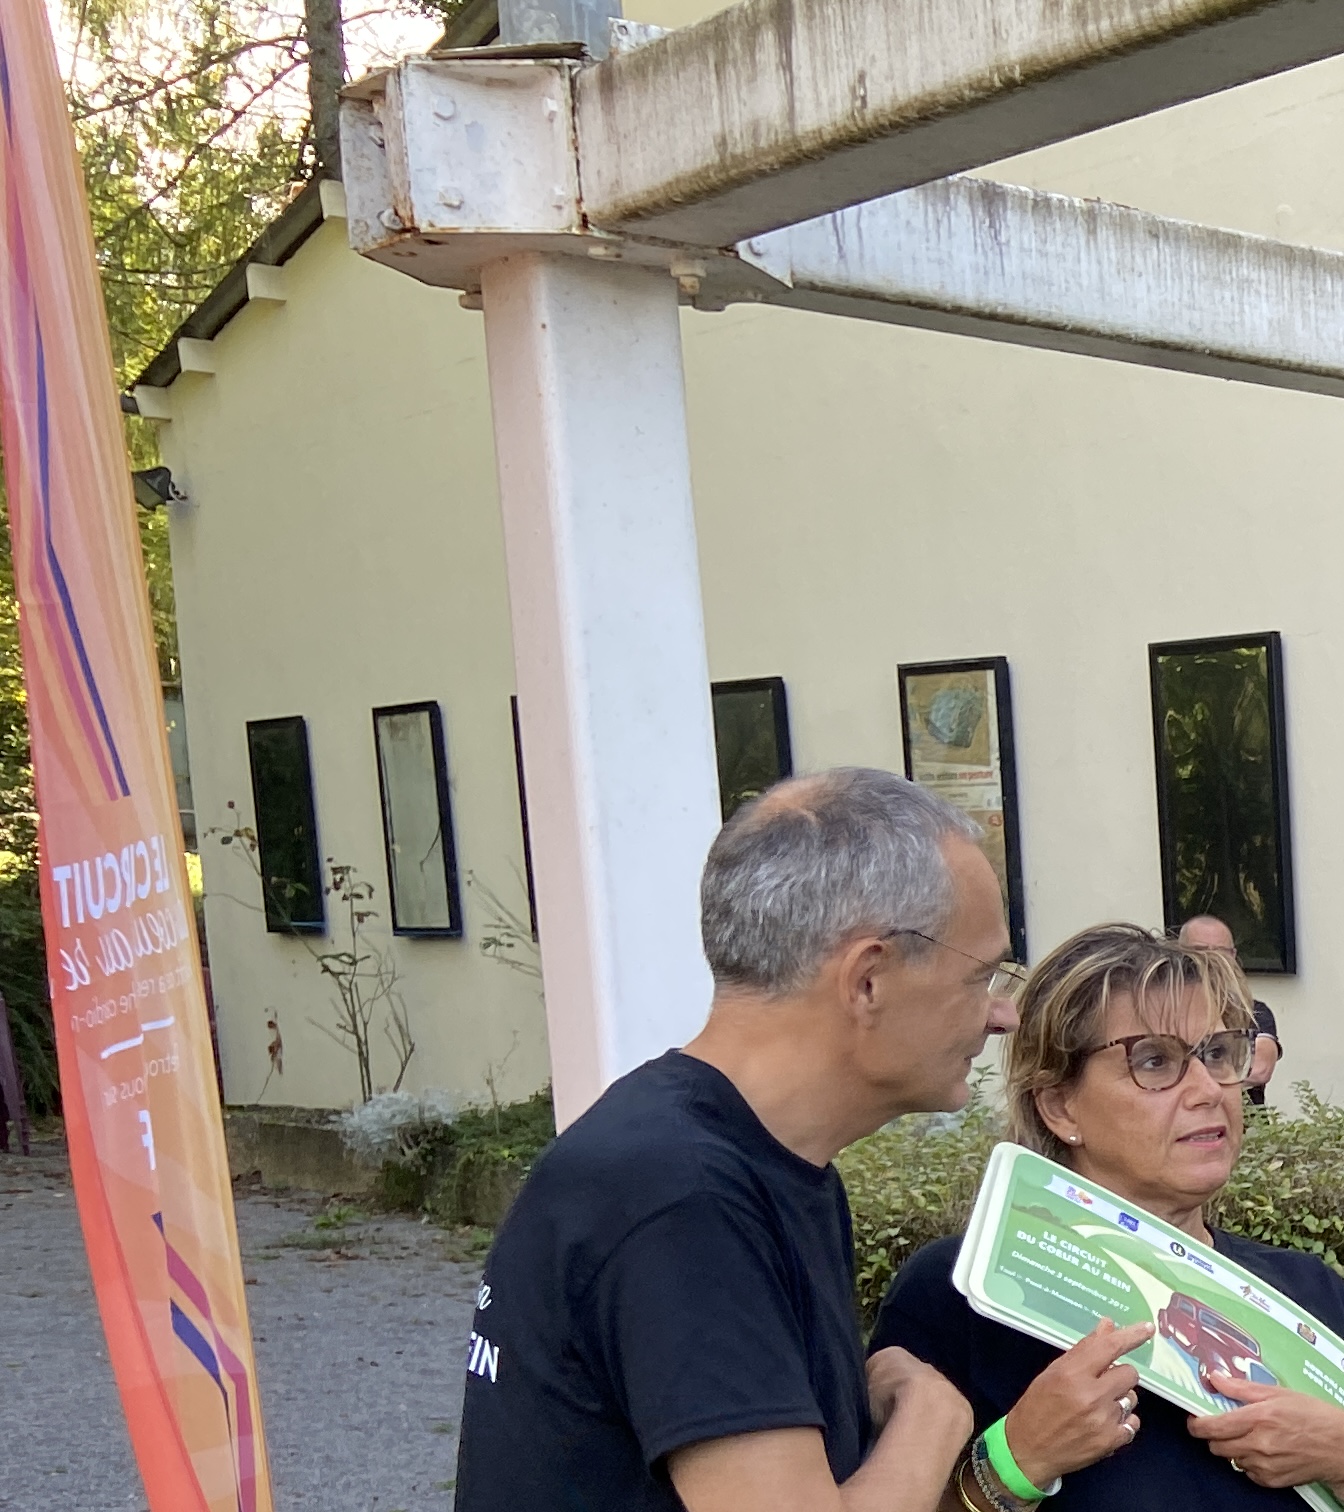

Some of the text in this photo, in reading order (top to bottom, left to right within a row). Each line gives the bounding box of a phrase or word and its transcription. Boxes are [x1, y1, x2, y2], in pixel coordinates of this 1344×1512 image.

[1017, 1230, 1131, 1293] DU COEUR AU REIN
[1043, 1231, 1107, 1268] LE CIRCUIT
[1011, 1250, 1056, 1275] Dimanche
[1063, 1276, 1108, 1301] septembre
